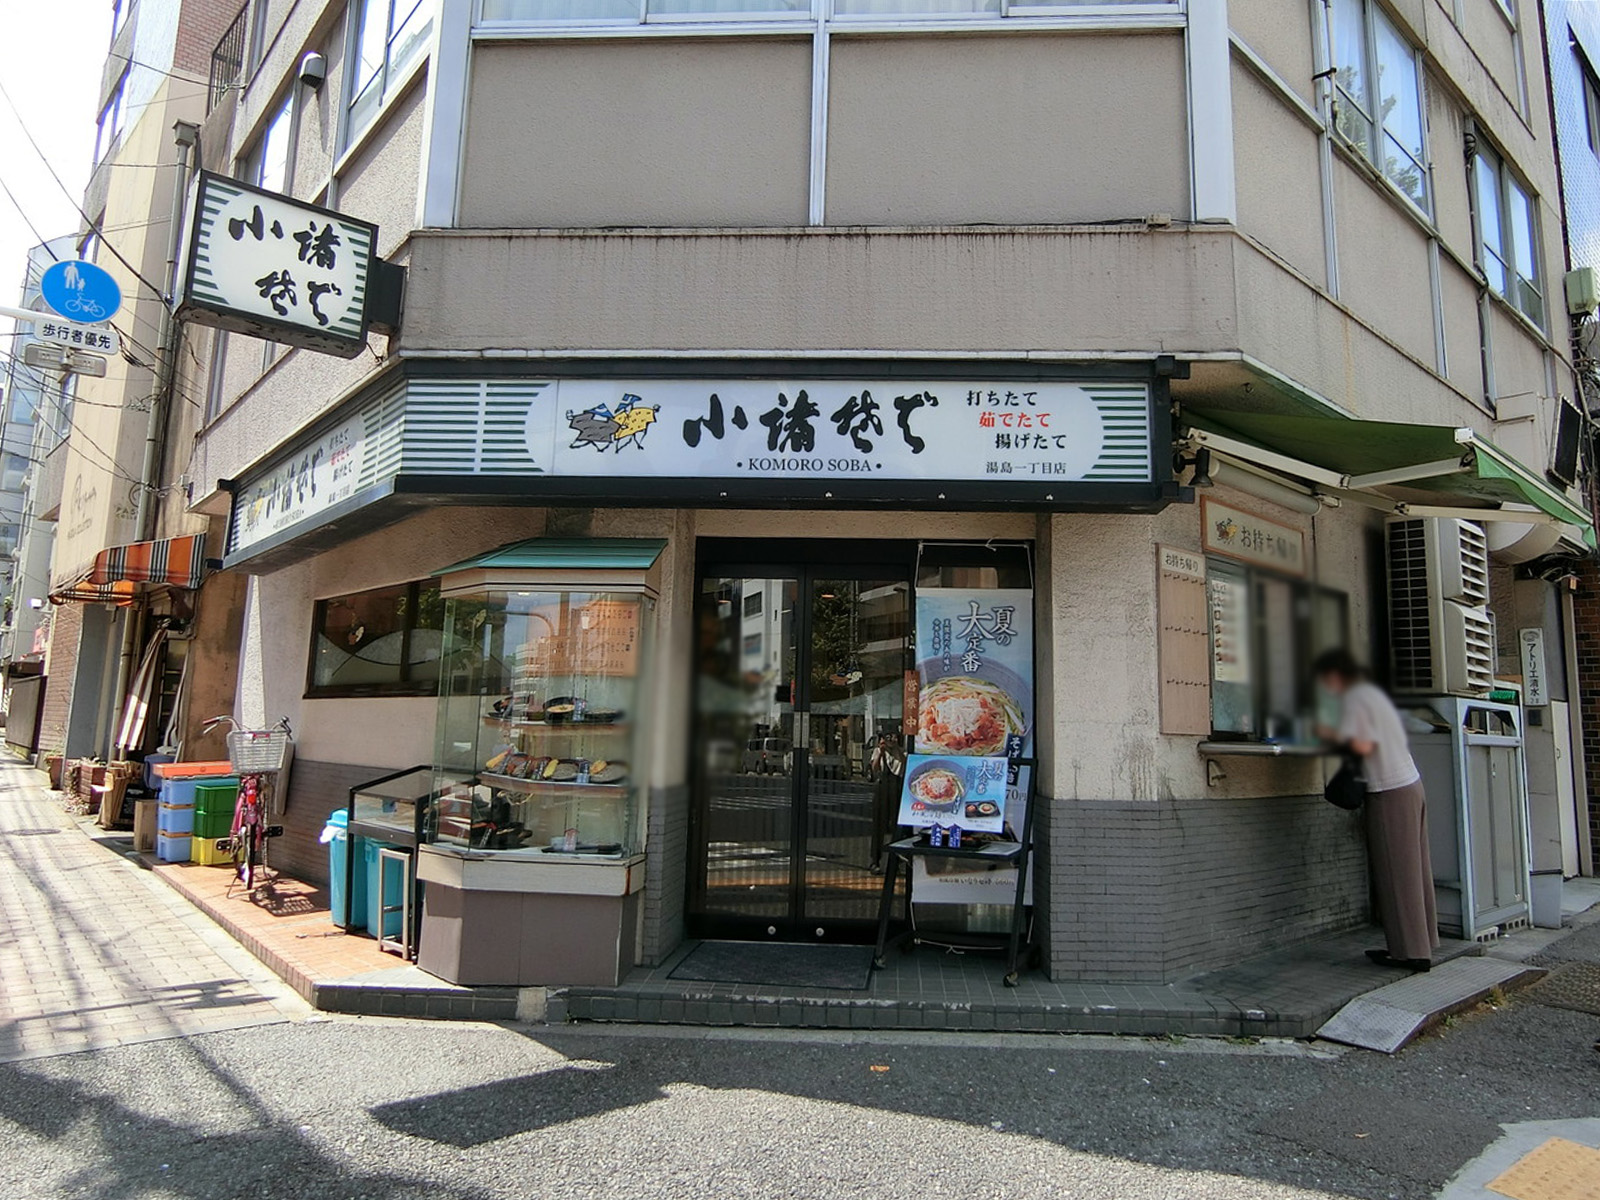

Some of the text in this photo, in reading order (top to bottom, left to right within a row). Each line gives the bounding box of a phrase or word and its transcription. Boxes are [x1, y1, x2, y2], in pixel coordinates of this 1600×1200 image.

[43, 323, 111, 349] 歩行者優先
[966, 390, 1038, 407] 打ちたて
[979, 411, 1051, 428] 茹でたて
[995, 433, 1067, 450] 揚げたて
[748, 458, 872, 472] KOMORO SOBA
[986, 461, 1067, 475] 湯島一丁目店
[1165, 553, 1199, 572] お持ち帰り
[991, 605, 1018, 646] 夏の
[957, 601, 996, 673] 大定番
[1526, 643, 1540, 697] アトリエ清水
